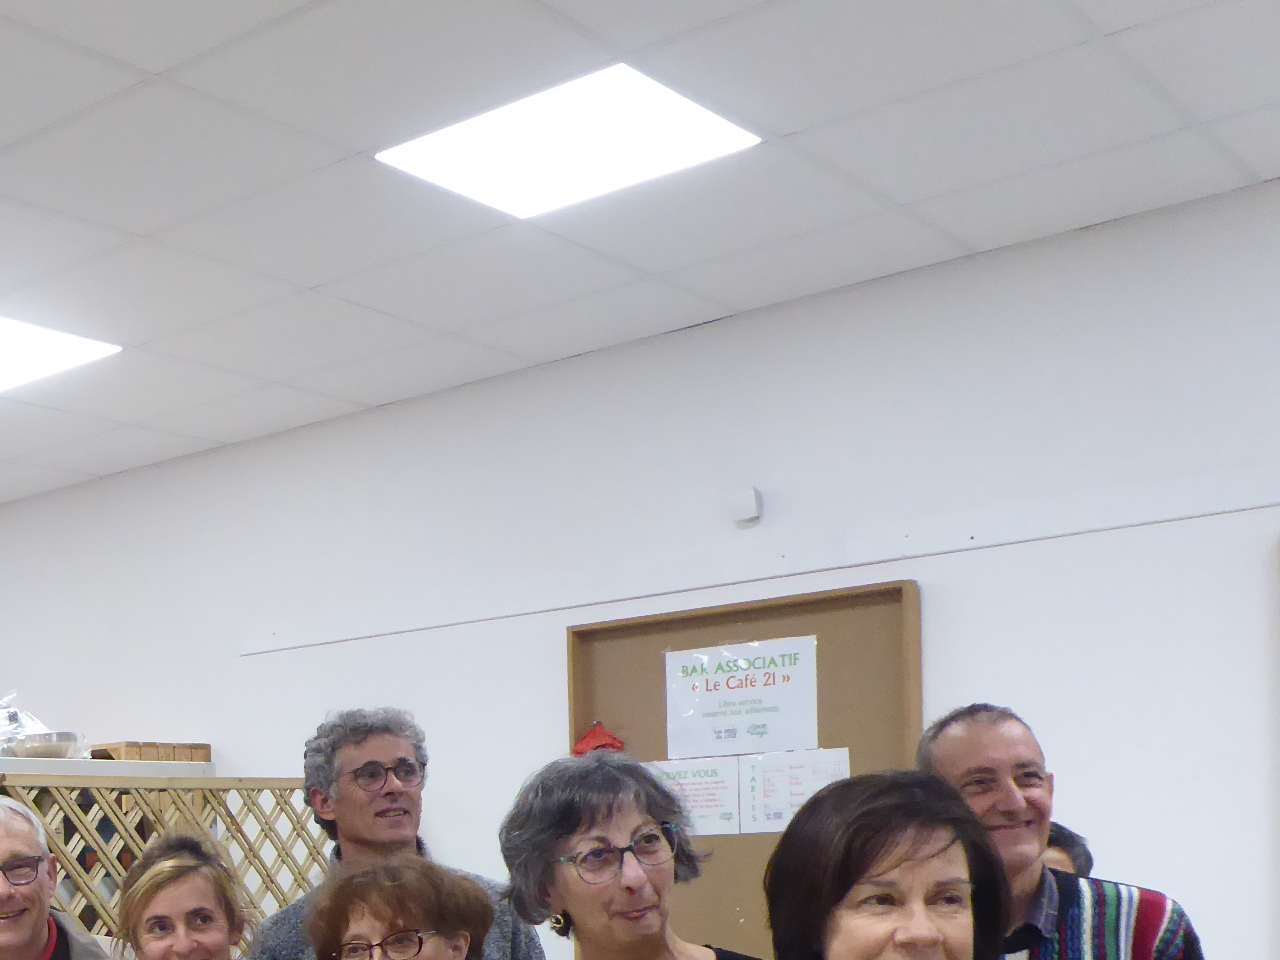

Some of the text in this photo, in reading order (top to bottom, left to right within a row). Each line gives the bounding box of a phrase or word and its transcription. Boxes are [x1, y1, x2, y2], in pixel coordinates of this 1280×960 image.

[714, 653, 800, 675] ASSOCIATIF
[705, 678, 721, 692] Le
[725, 673, 757, 690] Café
[691, 768, 718, 779] VOUS
